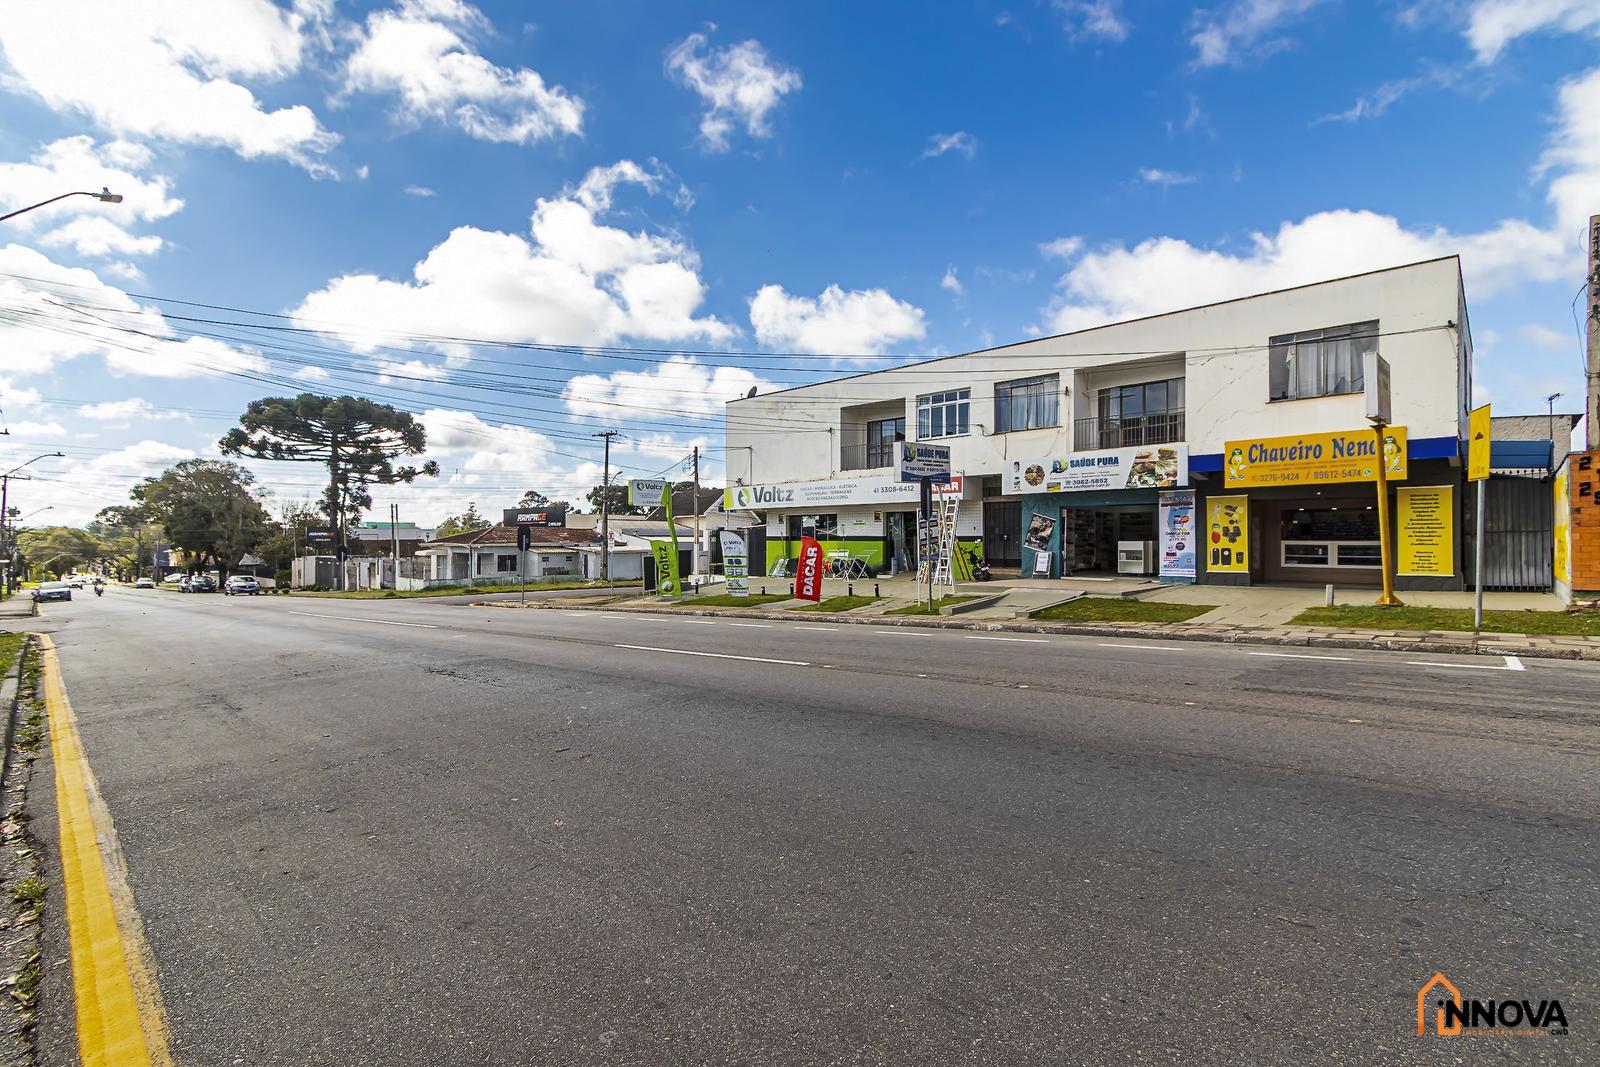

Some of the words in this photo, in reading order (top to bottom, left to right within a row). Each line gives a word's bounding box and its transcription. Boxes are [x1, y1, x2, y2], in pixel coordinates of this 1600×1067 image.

[916, 447, 934, 459] SAÚDE
[935, 449, 949, 460] PURA
[1248, 440, 1322, 464] Chaveiro
[1070, 457, 1096, 468] SAÚDE
[1097, 456, 1119, 466] PURA
[753, 485, 794, 503] Voltz
[880, 485, 915, 493] 3308-6412
[517, 512, 547, 522] RAMPAGE
[659, 545, 671, 580] Voltz
[803, 547, 818, 596] DACAR
